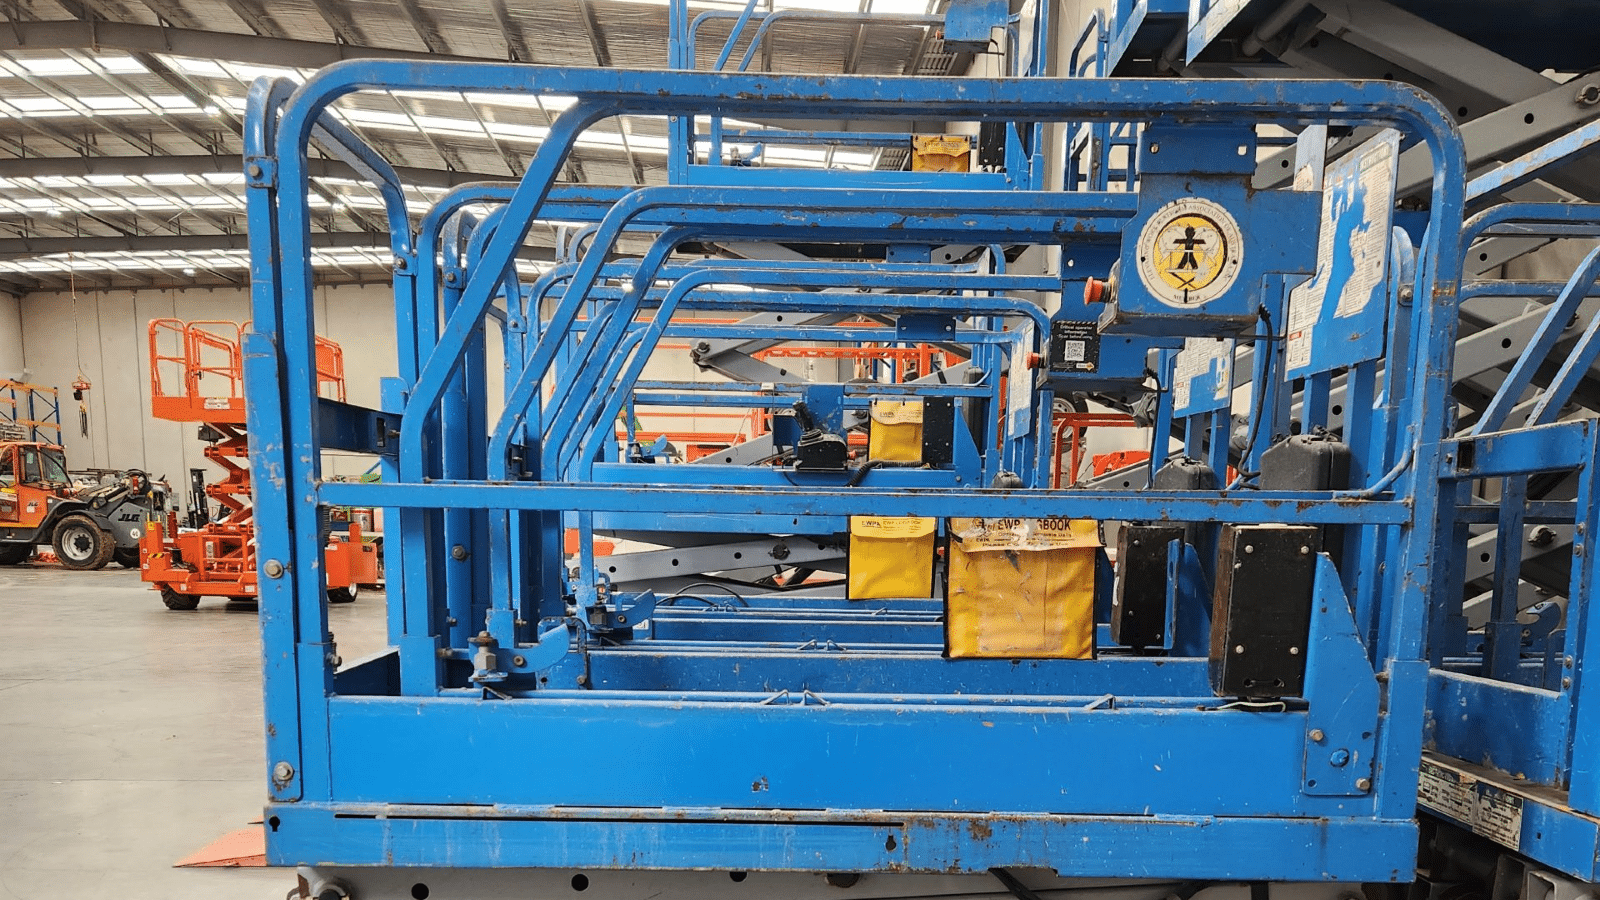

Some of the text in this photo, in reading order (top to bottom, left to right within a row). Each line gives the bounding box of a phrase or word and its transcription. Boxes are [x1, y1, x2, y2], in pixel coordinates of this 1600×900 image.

[1188, 204, 1225, 223] ASSOCIATION
[118, 513, 140, 523] JLG
[998, 518, 1021, 530] EWP
[1037, 518, 1071, 531] GBOOK
